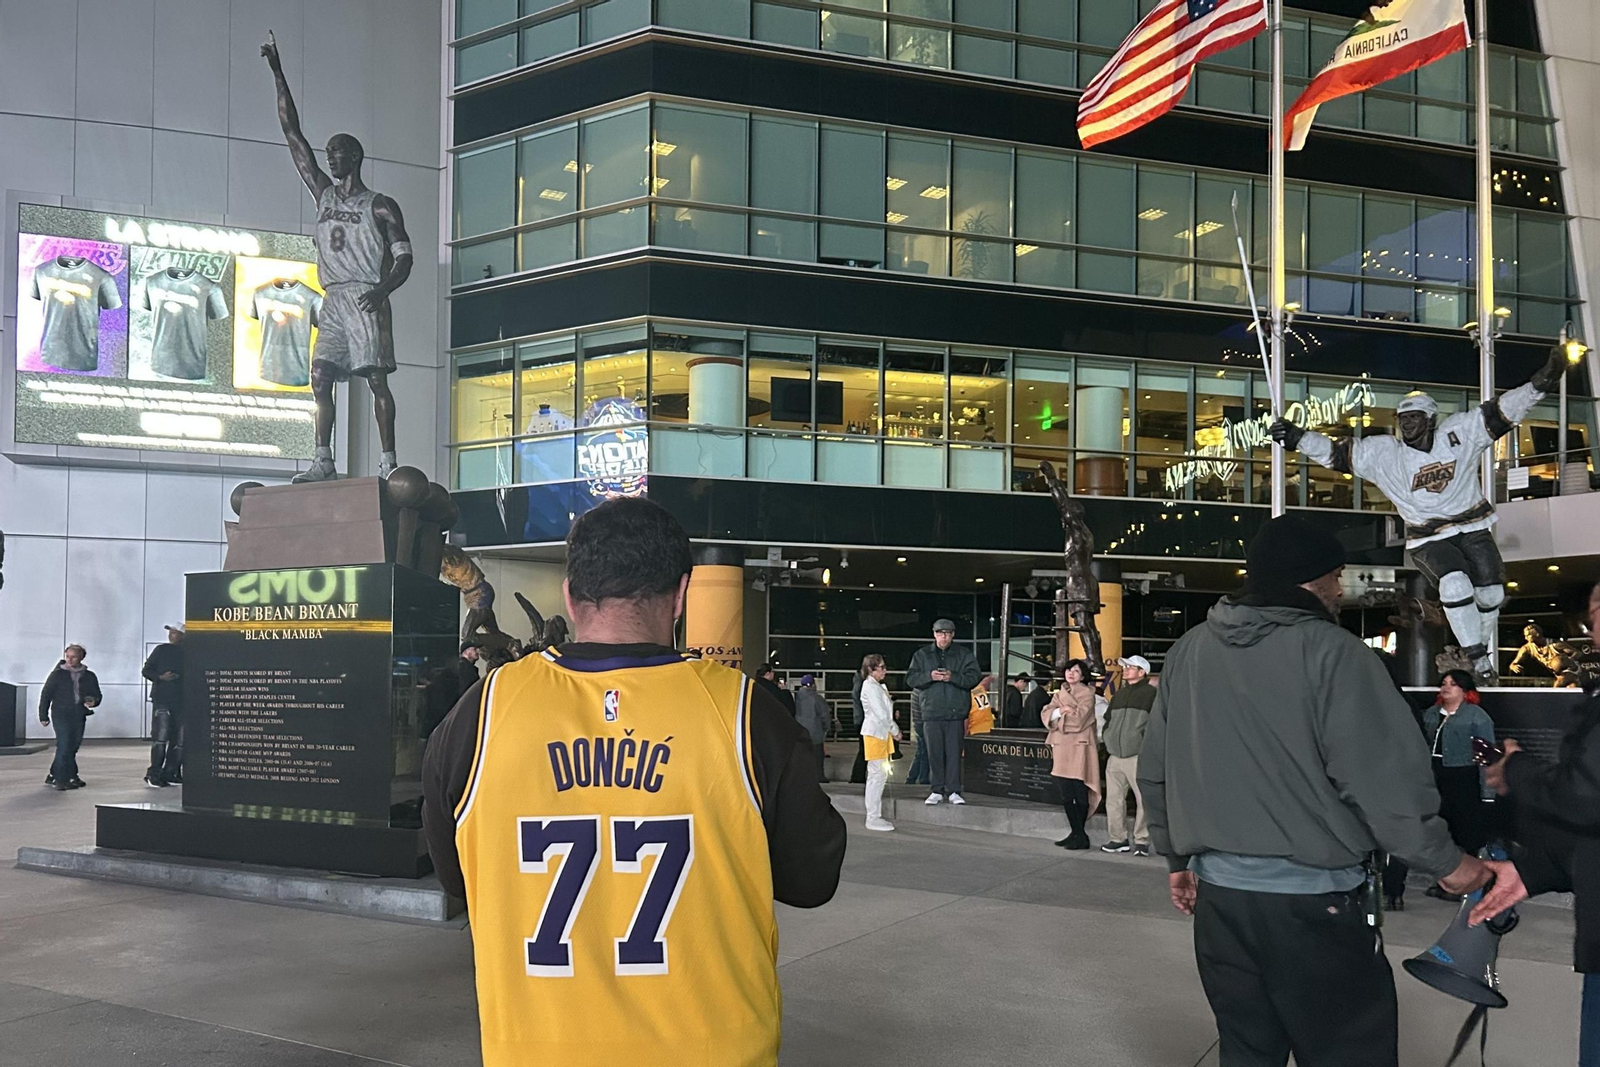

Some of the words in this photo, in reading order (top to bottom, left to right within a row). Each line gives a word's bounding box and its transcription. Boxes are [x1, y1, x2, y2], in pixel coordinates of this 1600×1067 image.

[330, 224, 346, 253] 8
[1447, 430, 1461, 448] A
[213, 607, 250, 622] KOBE
[255, 605, 294, 621] BEAN
[298, 603, 359, 620] BRYANT
[974, 693, 991, 710] 12
[982, 743, 1008, 755] OSCAR
[1010, 746, 1021, 756] DE
[1024, 746, 1034, 758] LA
[547, 728, 674, 793] DONČIĆ
[516, 814, 695, 977] 77
